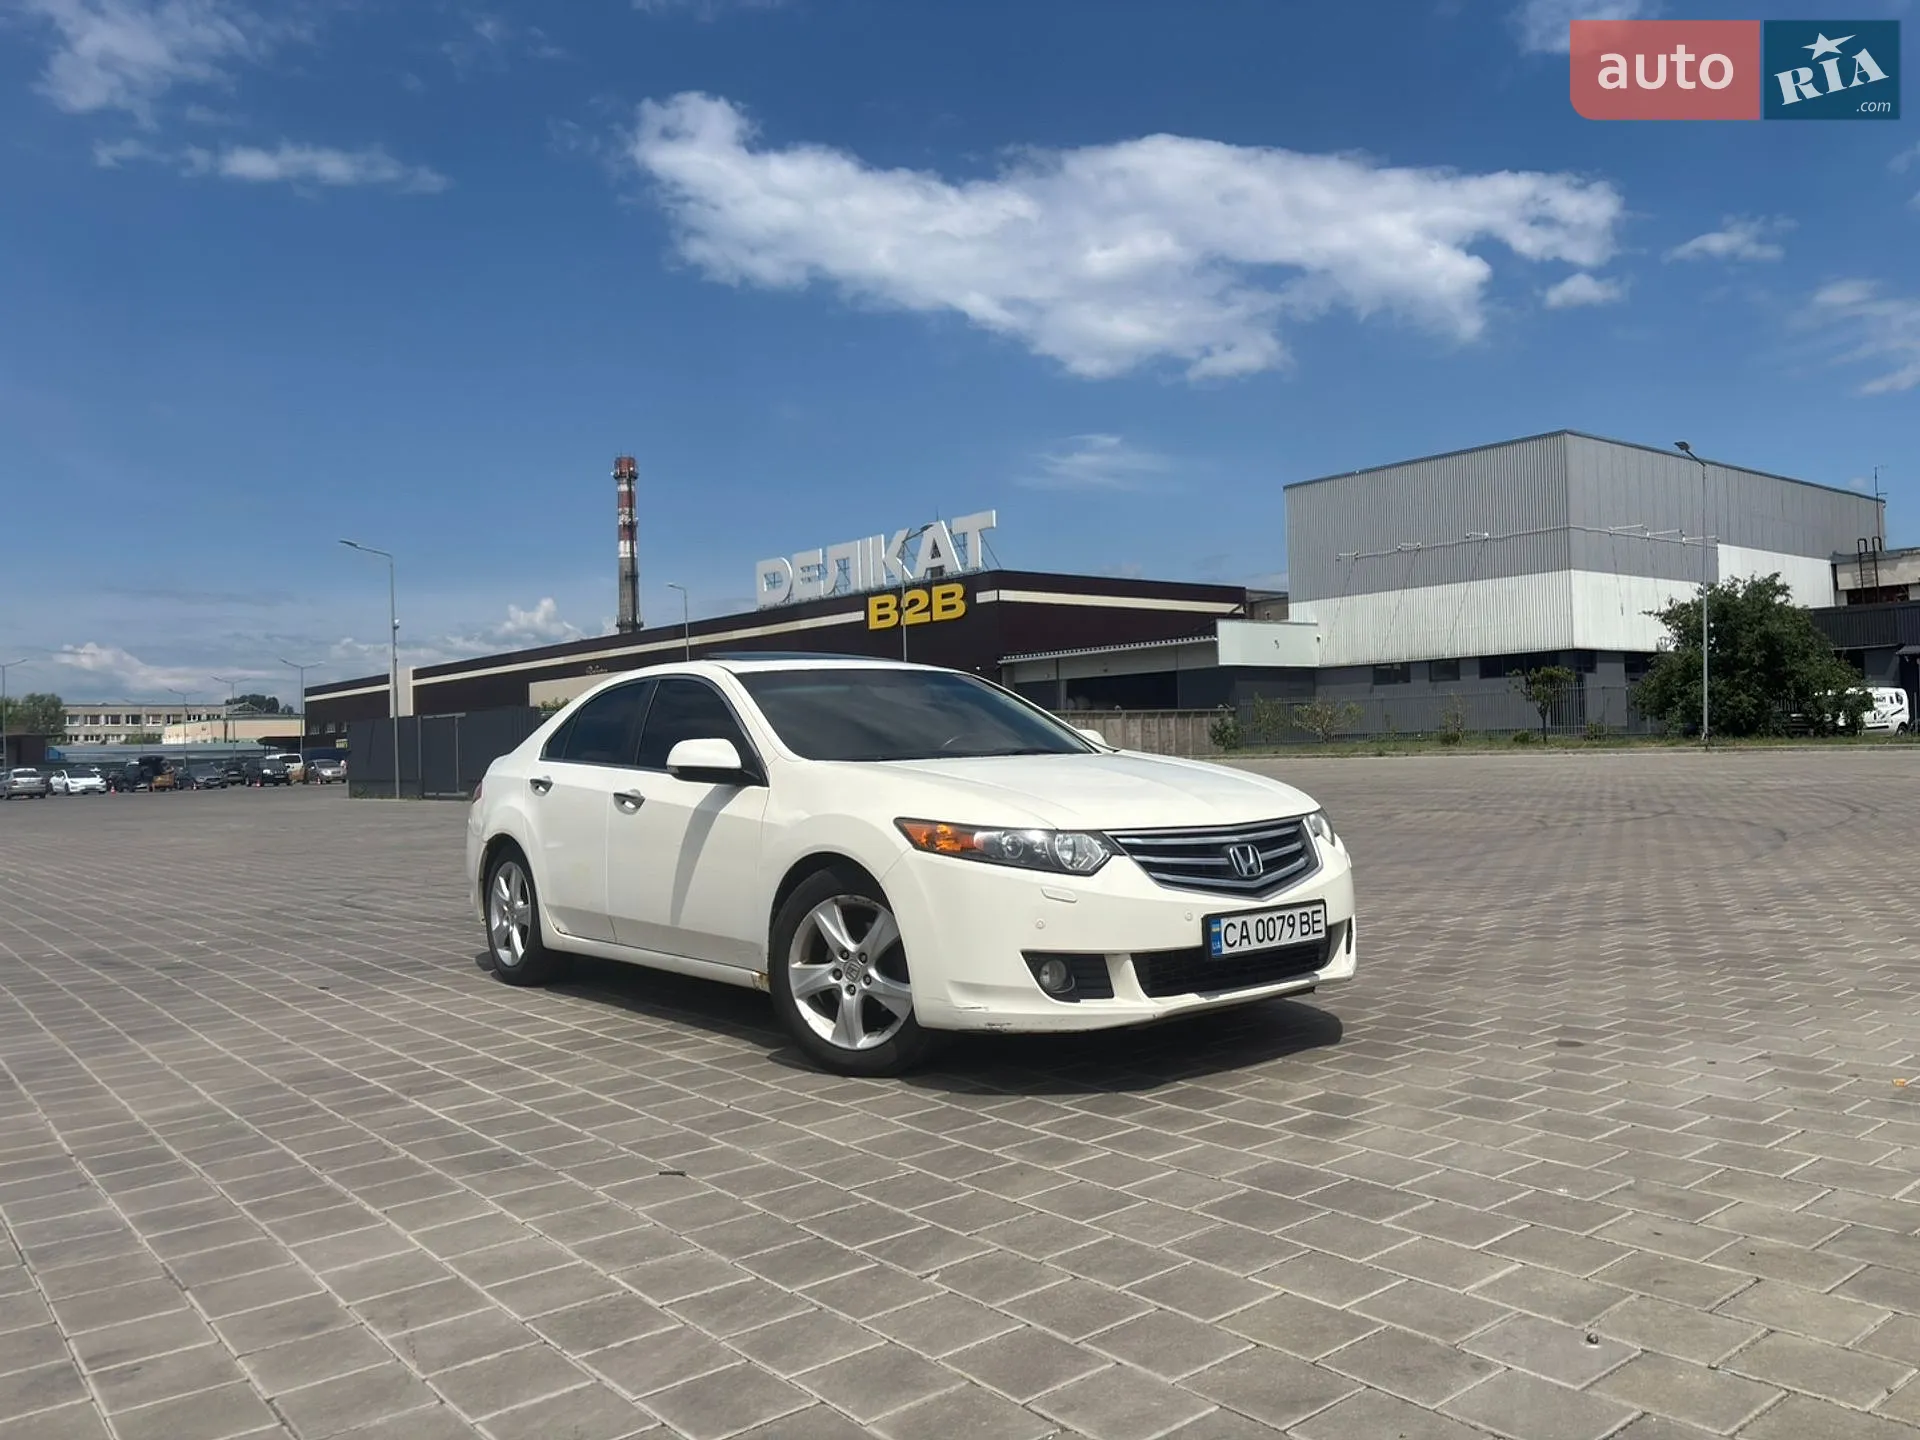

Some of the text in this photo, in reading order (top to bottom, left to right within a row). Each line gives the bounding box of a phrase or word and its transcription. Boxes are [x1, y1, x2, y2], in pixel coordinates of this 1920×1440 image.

[868, 583, 967, 630] B2B
[1224, 909, 1323, 948] CA 0079 BE
